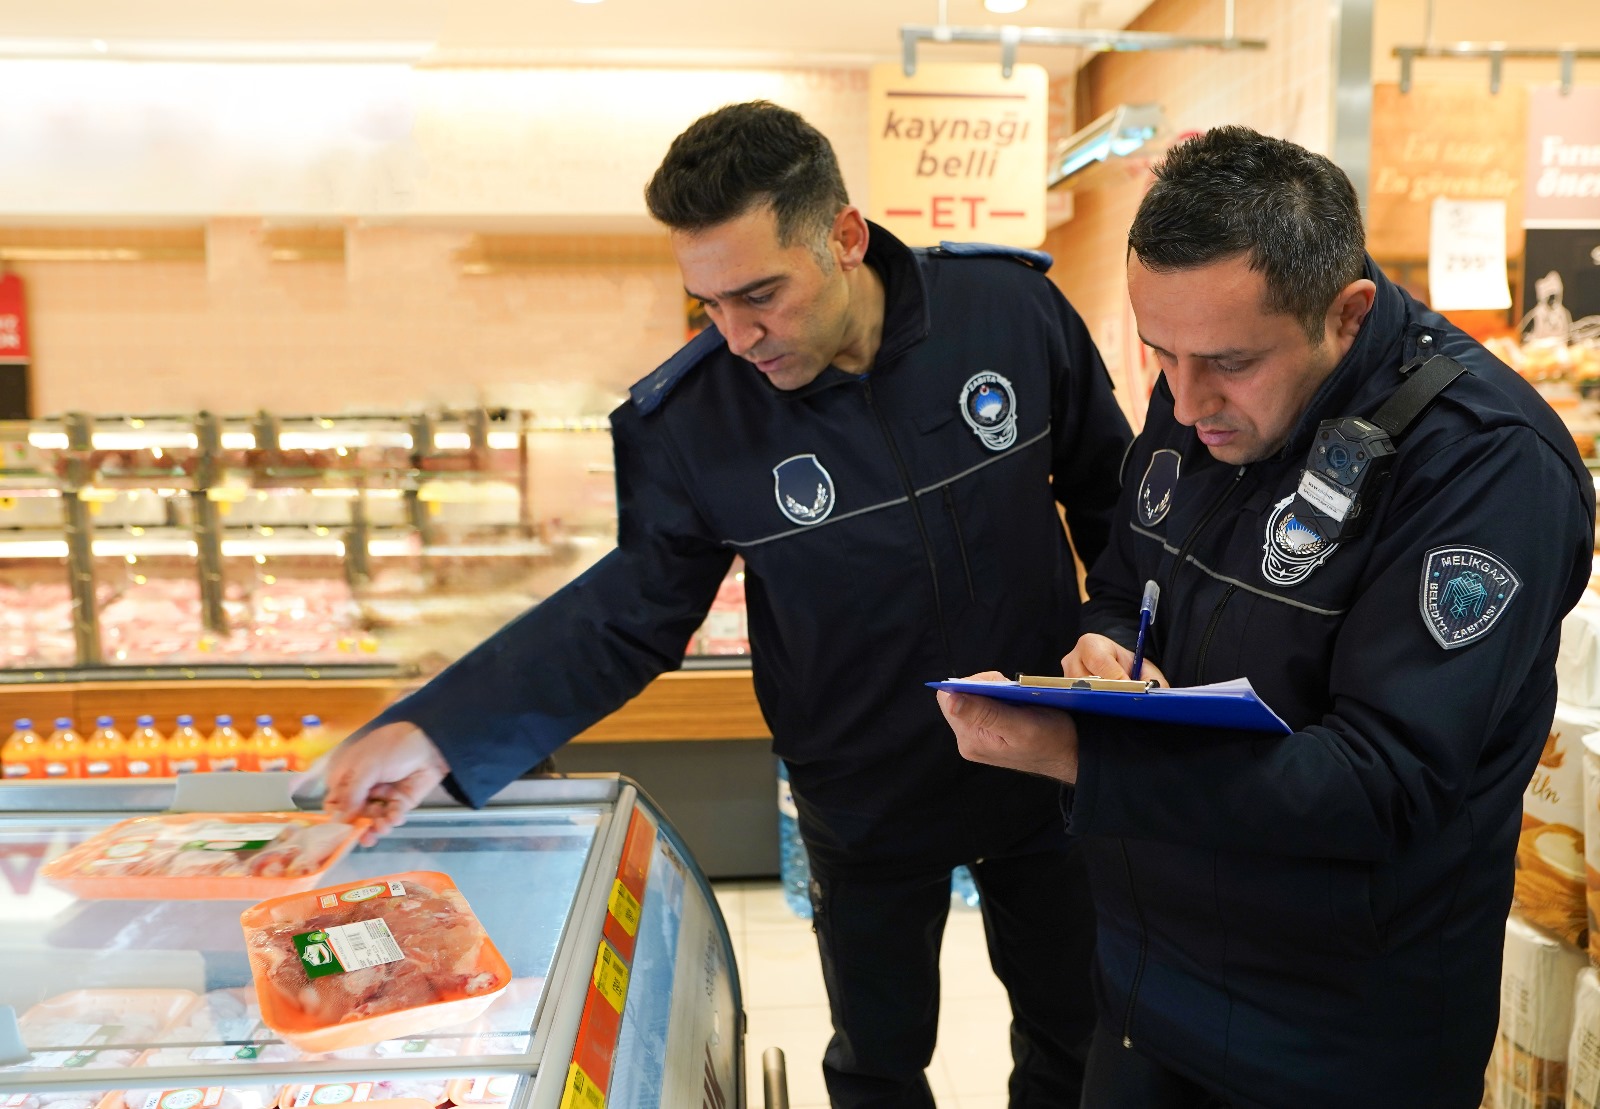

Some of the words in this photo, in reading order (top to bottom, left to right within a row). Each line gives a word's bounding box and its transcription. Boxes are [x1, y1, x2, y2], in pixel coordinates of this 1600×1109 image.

[882, 110, 1030, 147] kaynağı
[915, 149, 998, 179] belli
[931, 197, 986, 229] ET
[1441, 555, 1510, 587] MELİKGAZİ
[1429, 582, 1450, 636] BELEDİYE
[1452, 605, 1497, 640] ZABITASI
